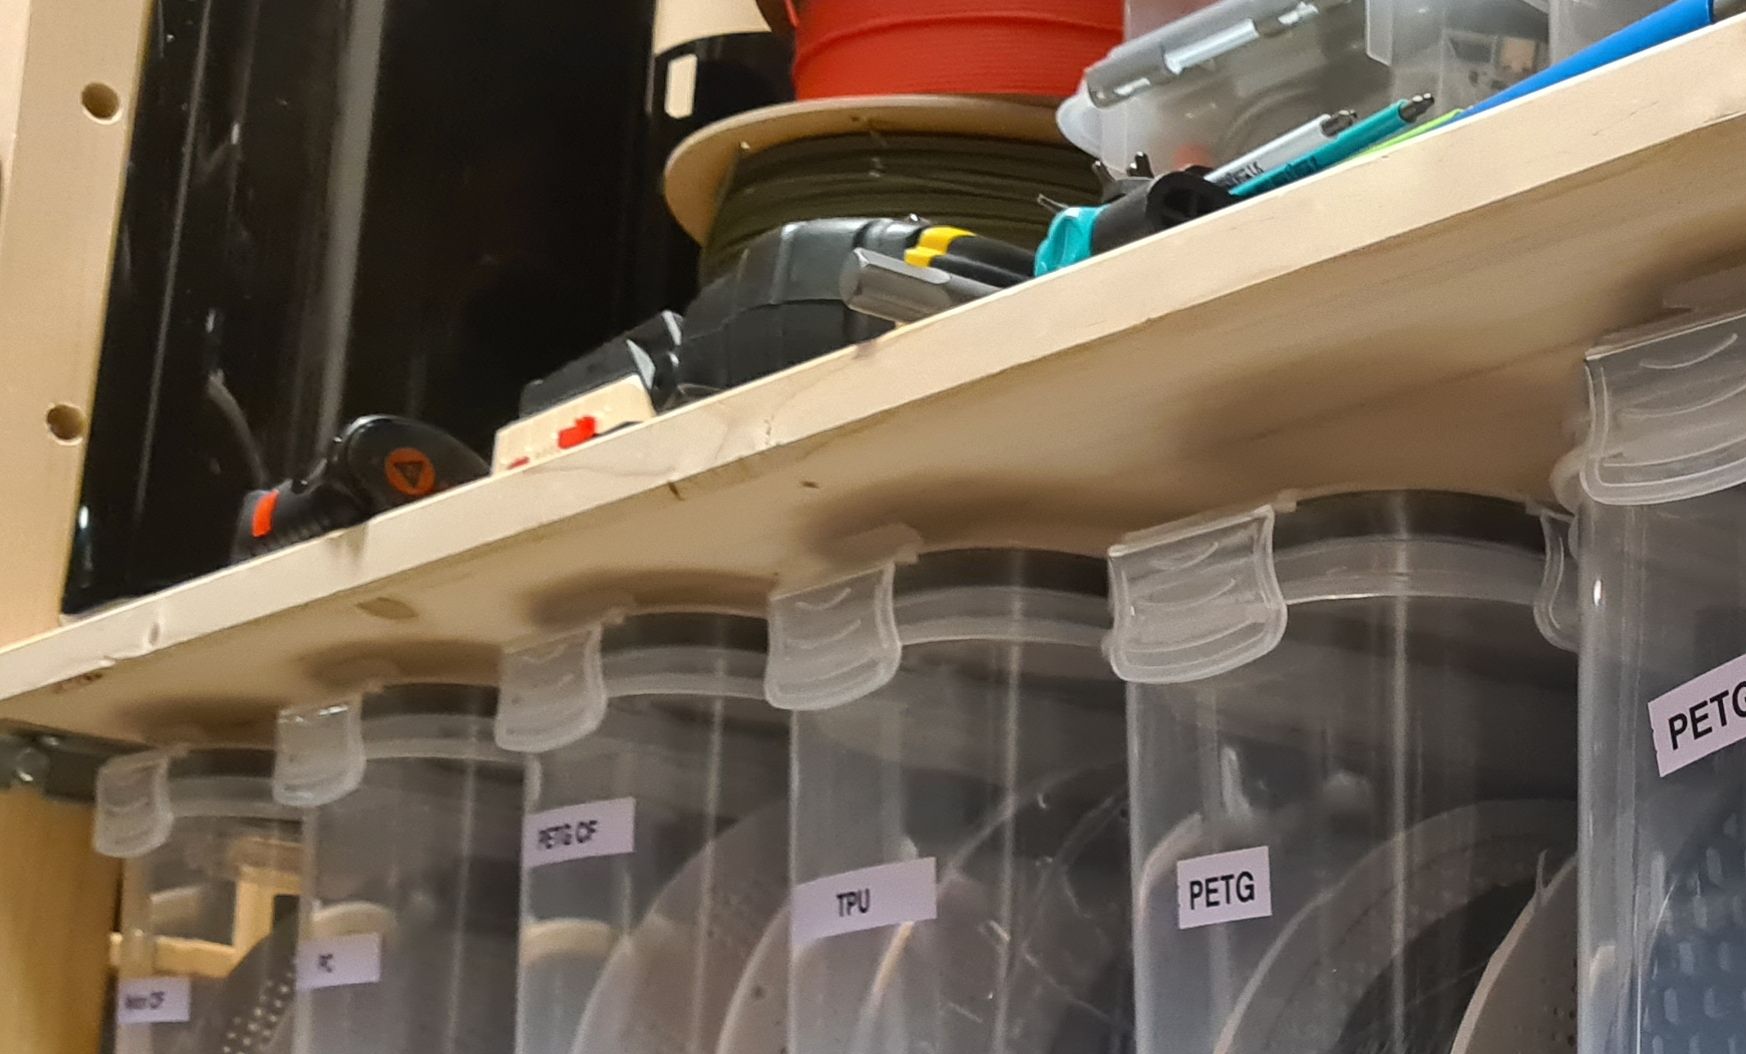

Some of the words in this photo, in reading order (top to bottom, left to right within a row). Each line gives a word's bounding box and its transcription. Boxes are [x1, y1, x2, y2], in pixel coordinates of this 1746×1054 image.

[537, 824, 572, 850] PETG
[576, 819, 598, 844] CF
[836, 888, 871, 917] TPU
[1189, 870, 1255, 911] PETG
